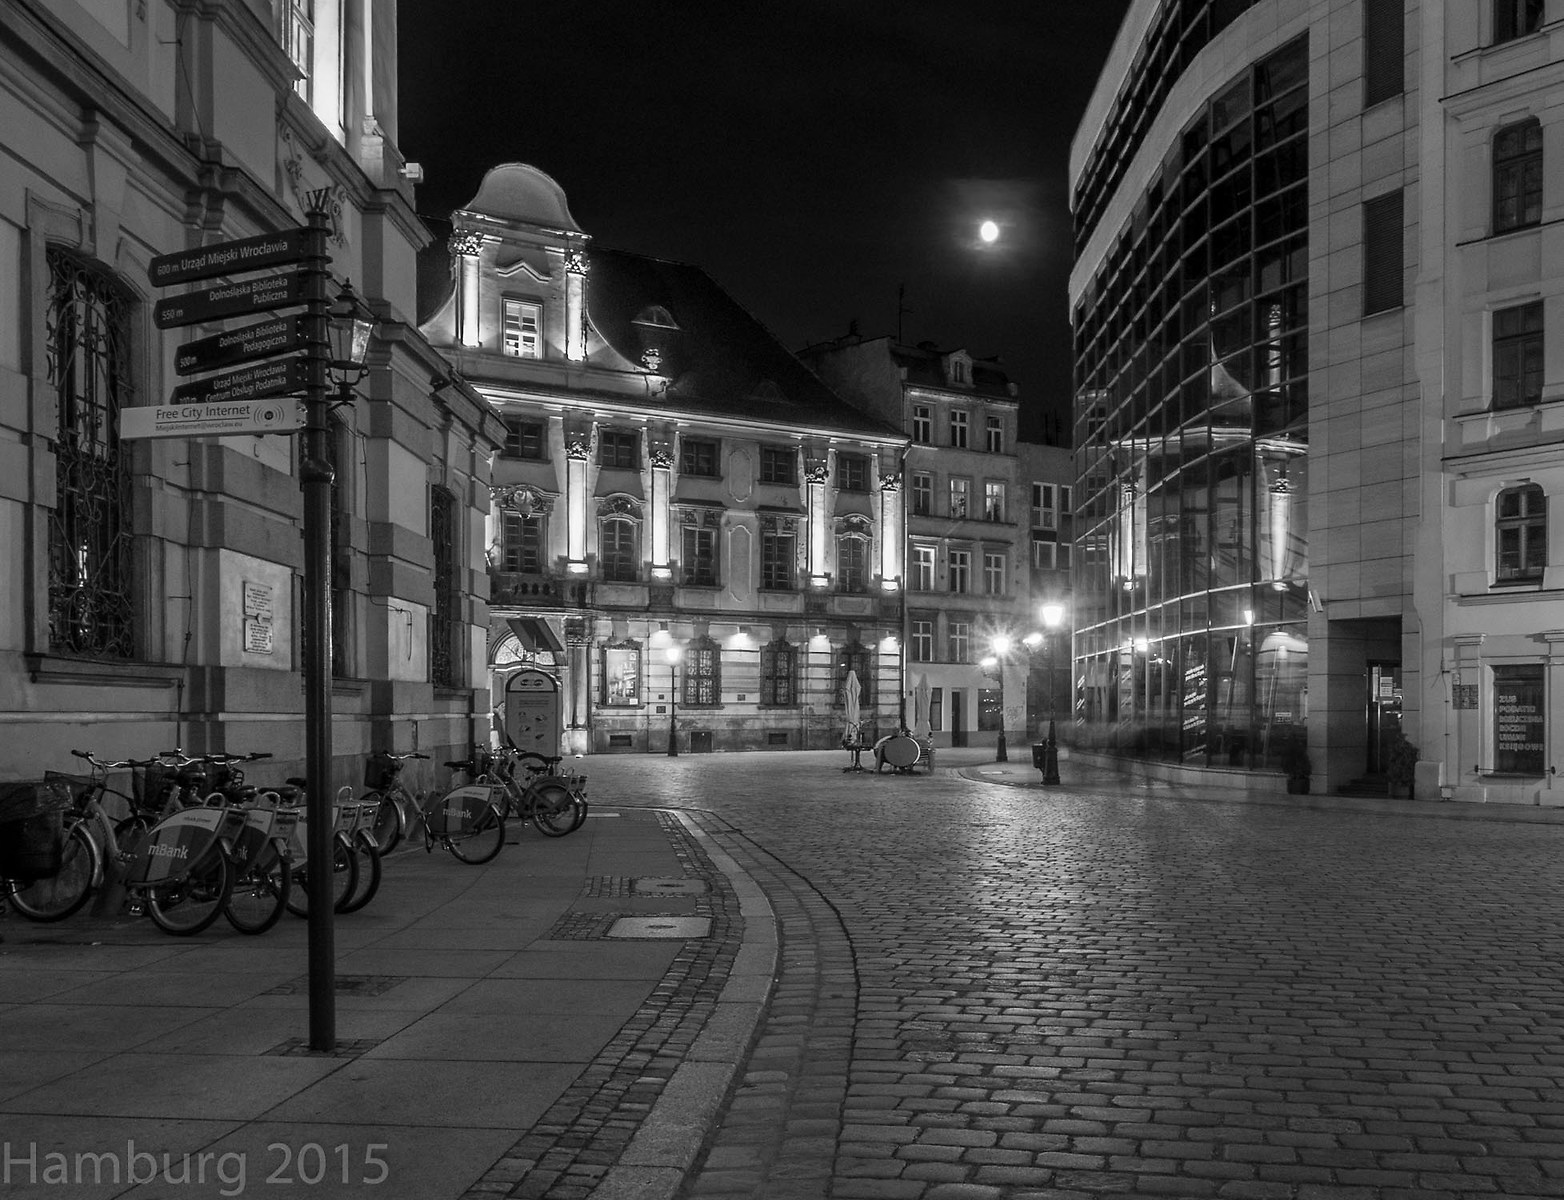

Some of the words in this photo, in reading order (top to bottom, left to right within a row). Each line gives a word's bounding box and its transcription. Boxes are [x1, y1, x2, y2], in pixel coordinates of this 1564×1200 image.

[171, 264, 180, 273] m
[181, 255, 206, 271] Urząd
[208, 248, 238, 265] Miejski
[240, 239, 288, 259] Wrocławia
[252, 277, 288, 293] Biblioteka
[252, 289, 288, 305] Publiczna
[255, 322, 287, 338] Biblioteka
[243, 334, 287, 353] Pedagogiczna
[156, 409, 179, 419] Free
[181, 407, 203, 420] City
[206, 405, 250, 417] Internet
[442, 808, 472, 819] mBank
[148, 843, 189, 860] mBank
